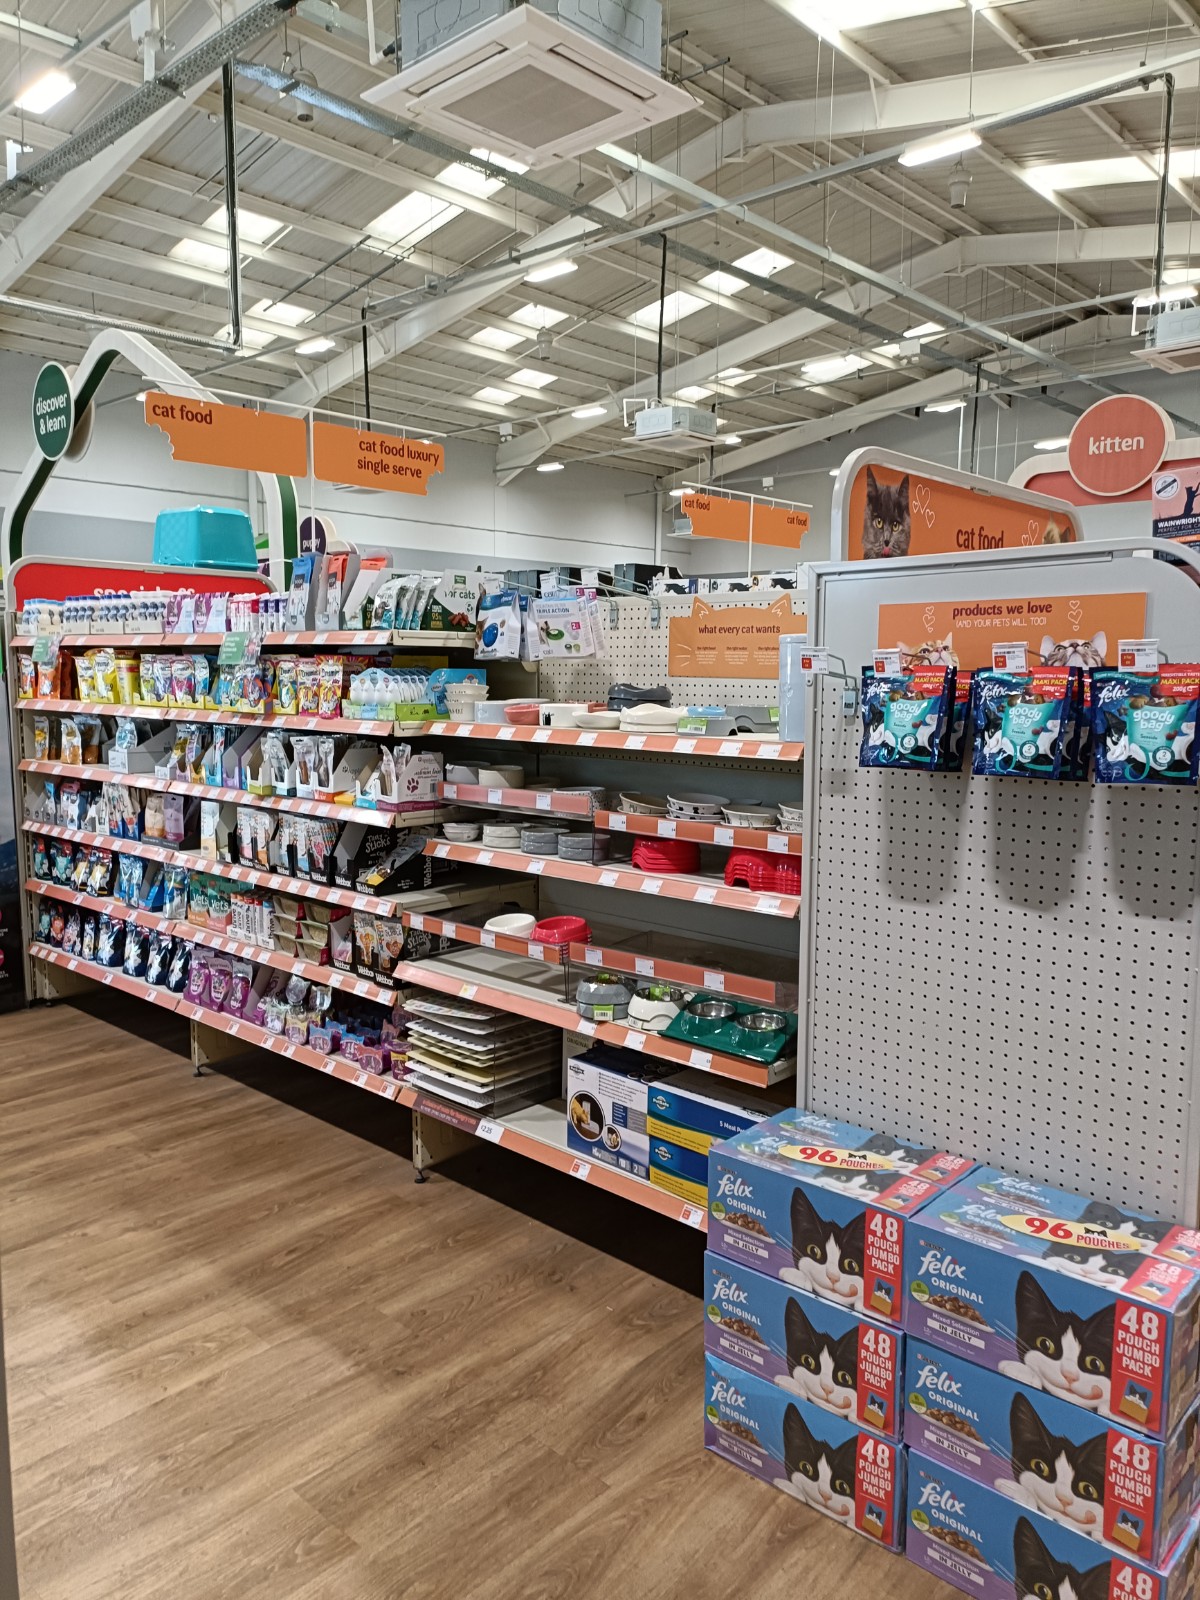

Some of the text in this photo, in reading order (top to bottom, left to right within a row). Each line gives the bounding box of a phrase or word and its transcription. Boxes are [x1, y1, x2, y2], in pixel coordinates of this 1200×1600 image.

[36, 393, 67, 416] discover
[152, 404, 212, 425] cat food
[39, 415, 66, 435] & learn
[359, 440, 440, 466] cat food luxury
[1088, 435, 1145, 456] kitten
[357, 458, 422, 479] single serve
[684, 499, 711, 511] cat food
[786, 516, 807, 527] cat food
[956, 528, 1005, 550] cat food
[459, 590, 476, 600] cats
[952, 601, 1053, 620] products we love
[698, 624, 781, 636] what every cat wants
[955, 619, 972, 628] (AND
[973, 618, 991, 628] YOUR
[992, 618, 1010, 627] PETS
[1011, 618, 1028, 626] WILL
[1098, 685, 1131, 708] felix
[890, 701, 922, 716] goody
[894, 710, 913, 722] bag
[1008, 706, 1043, 720] goody
[1133, 709, 1176, 725] goody
[1012, 716, 1033, 728] bag
[1140, 719, 1165, 732] bag
[423, 856, 432, 888] Webbo
[799, 1146, 838, 1163] 96
[839, 1158, 885, 1169] POUCHES
[716, 1174, 753, 1198] felix
[726, 1197, 767, 1220] ORIGINAL
[728, 1228, 765, 1248] Mixed Selection
[870, 1213, 898, 1242] 48
[1025, 1217, 1074, 1240] 96
[732, 1238, 740, 1247] IN
[741, 1241, 759, 1254] JELLY
[868, 1234, 899, 1254] POUCH
[1076, 1234, 1131, 1250] POUCHES
[866, 1246, 900, 1265] JUMBO
[871, 1257, 894, 1274] PACK
[917, 1250, 967, 1280] felix
[712, 1278, 748, 1304] felix
[931, 1277, 984, 1305] ORIGINAL
[722, 1301, 762, 1326] ORIGINAL
[932, 1312, 980, 1337] Mixed Selection
[1121, 1306, 1159, 1340] 48
[863, 1329, 891, 1358] 48
[939, 1324, 972, 1343] IN JELLY
[1118, 1329, 1160, 1355] POUCH
[728, 1343, 754, 1360] IN JELLY
[861, 1349, 892, 1371] POUCH
[1116, 1342, 1160, 1368] JUMBO
[860, 1360, 892, 1381] JUMBO
[1122, 1355, 1152, 1378] PACK
[864, 1371, 887, 1390] PACK
[915, 1364, 963, 1397] felix
[710, 1381, 747, 1408] felix
[928, 1390, 980, 1422] ORIGINAL
[719, 1404, 760, 1431] ORIGINAL
[861, 1438, 890, 1469] 48
[935, 1436, 969, 1458] IN JELLY
[1112, 1437, 1150, 1471] 48
[857, 1470, 892, 1491] JUMBO
[859, 1458, 891, 1481] POUCH
[1110, 1458, 1151, 1486] POUCH
[862, 1481, 885, 1500] PACK
[1108, 1472, 1152, 1497] JUMBO
[1114, 1484, 1144, 1507] PACK
[918, 1482, 967, 1518] felix
[931, 1508, 984, 1543] ORIGINAL
[938, 1554, 972, 1578] IN JELLY
[1116, 1565, 1153, 1600] 48
